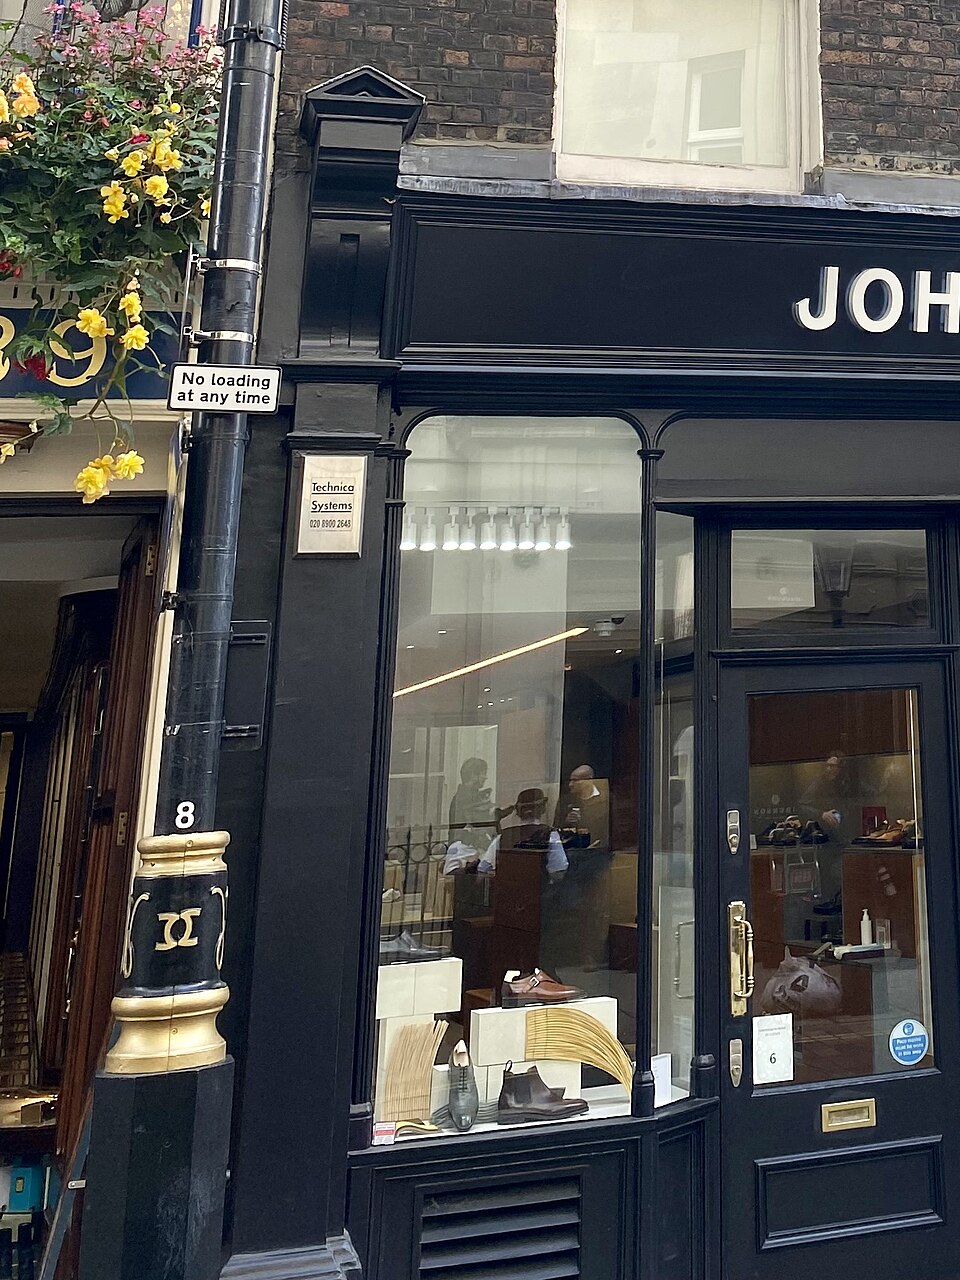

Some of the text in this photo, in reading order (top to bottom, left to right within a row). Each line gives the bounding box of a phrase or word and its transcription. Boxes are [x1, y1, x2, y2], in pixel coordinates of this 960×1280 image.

[181, 372, 271, 390] No loading
[177, 389, 271, 405] at any time
[311, 481, 355, 492] Technica
[311, 500, 353, 512] Systems
[309, 519, 321, 528] 020
[175, 801, 195, 829] 8
[769, 1052, 777, 1064] 6
